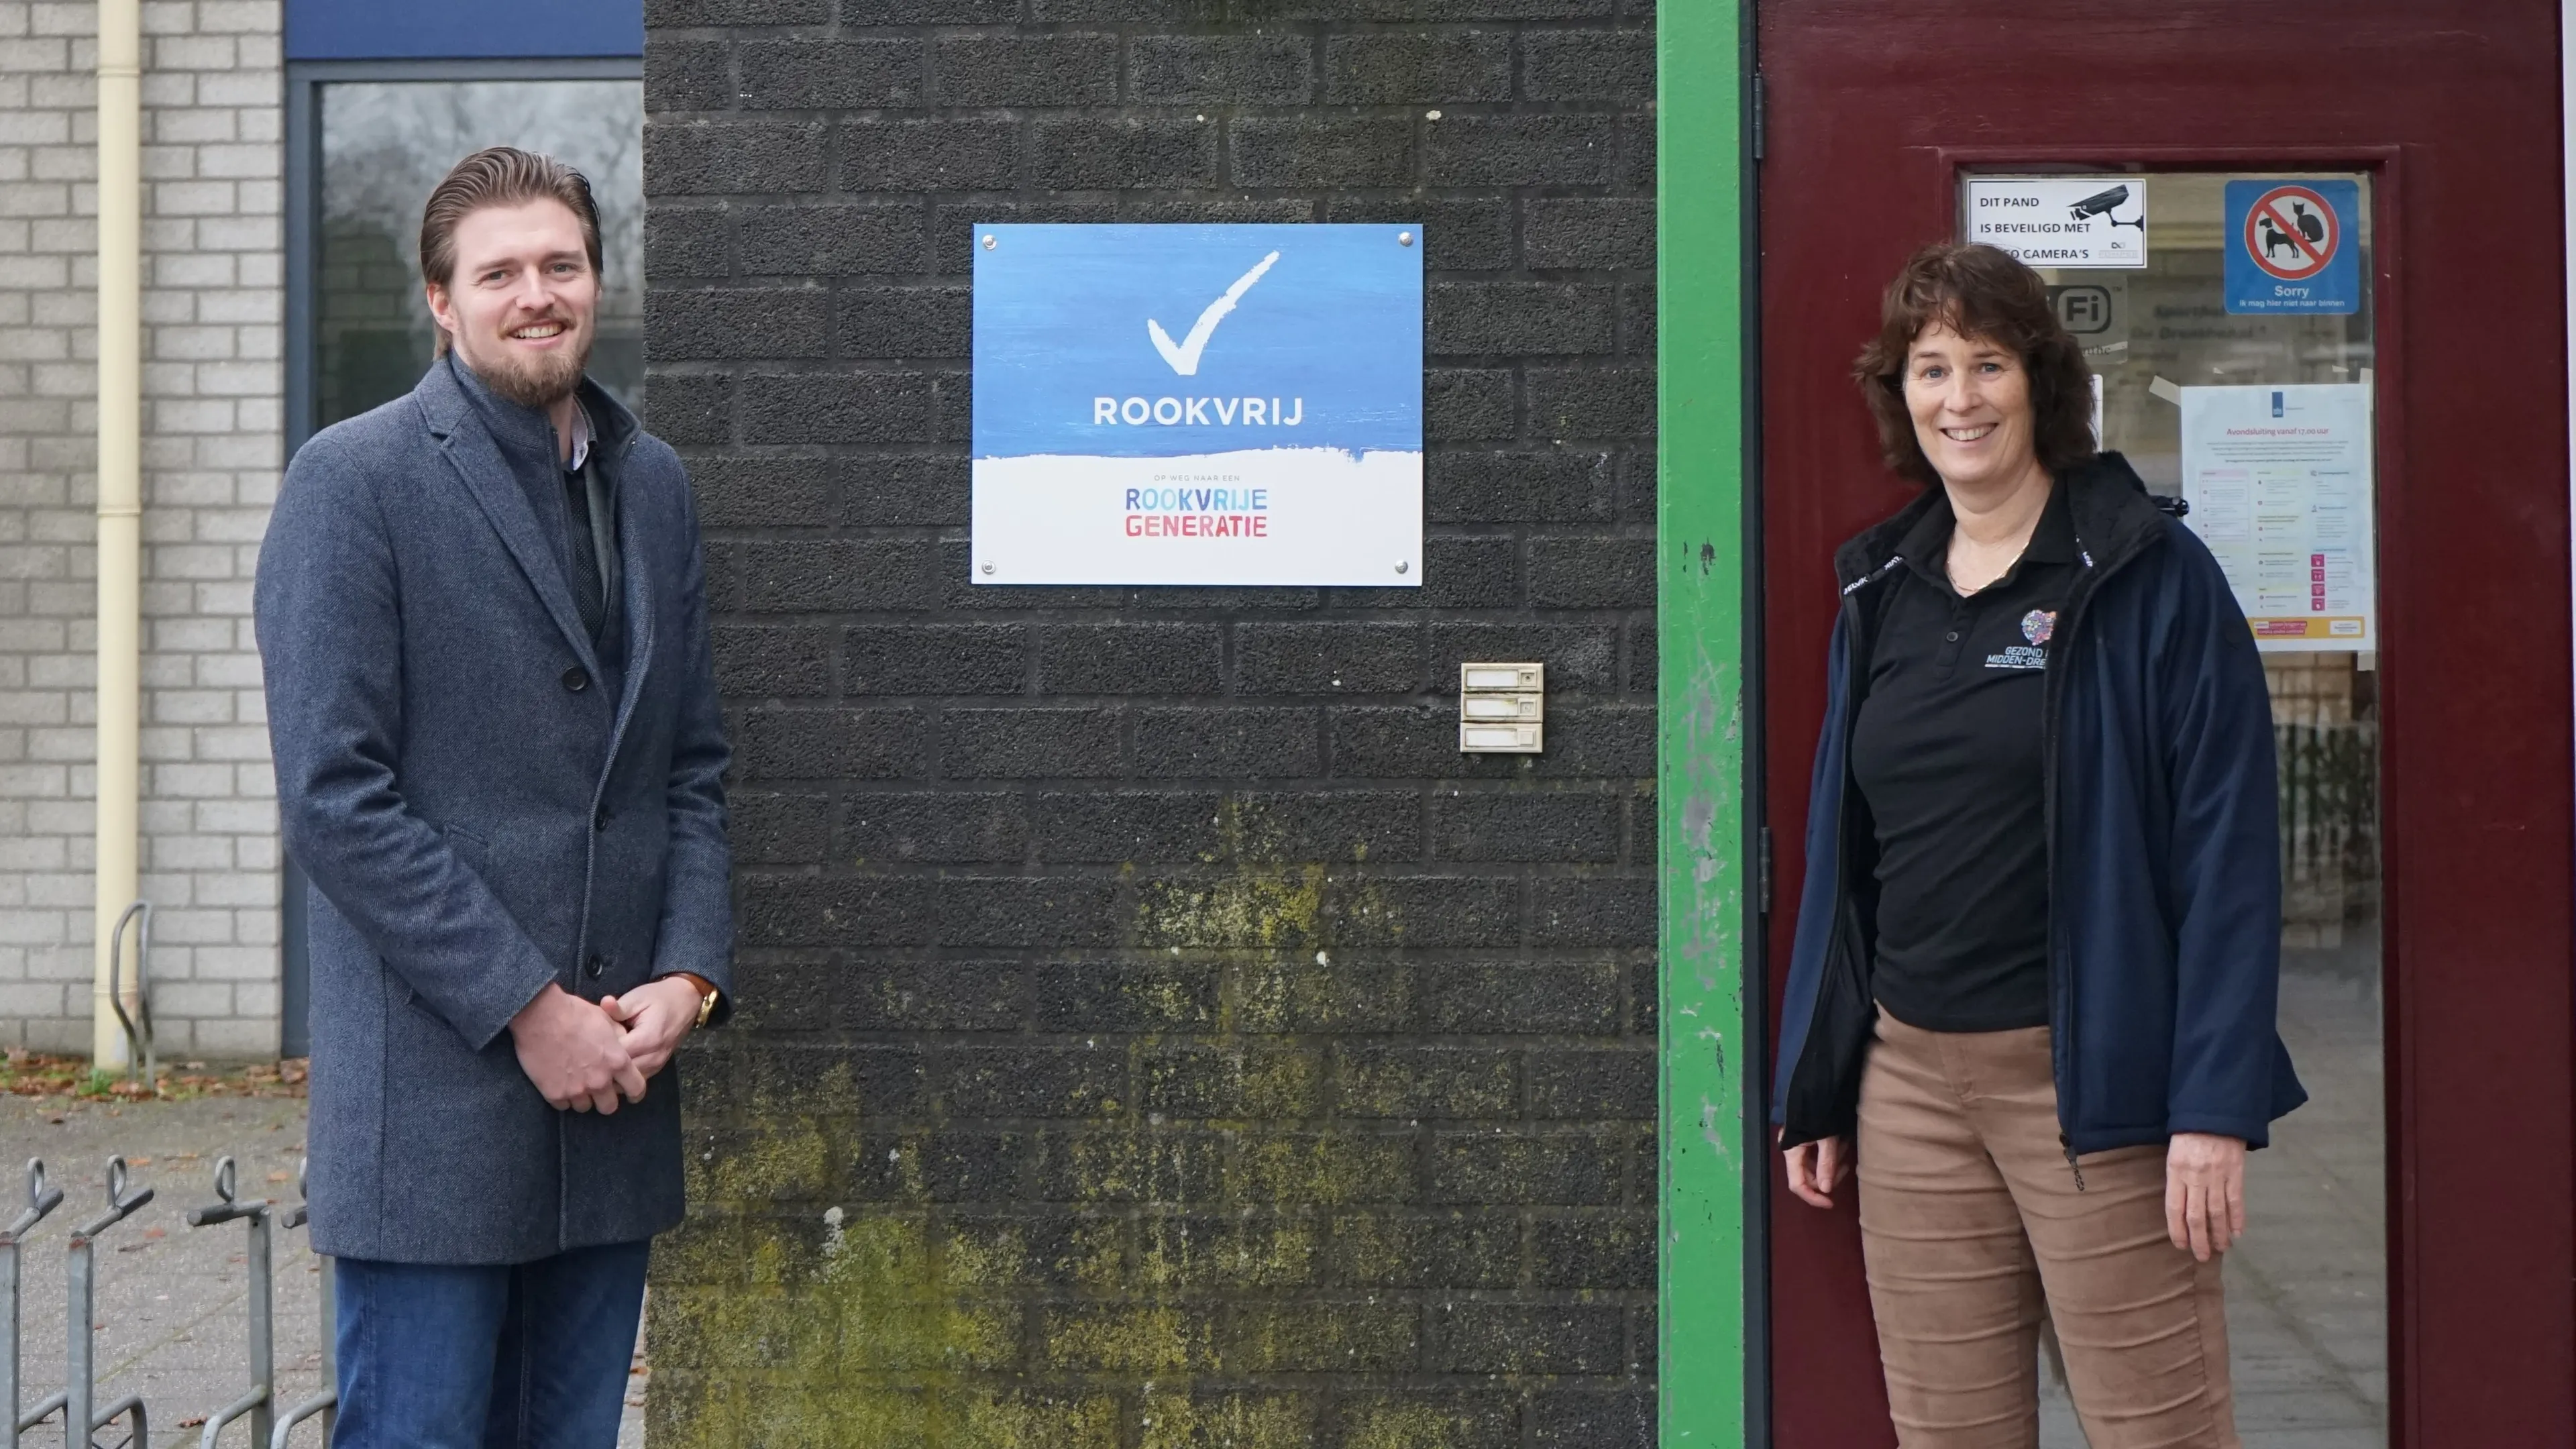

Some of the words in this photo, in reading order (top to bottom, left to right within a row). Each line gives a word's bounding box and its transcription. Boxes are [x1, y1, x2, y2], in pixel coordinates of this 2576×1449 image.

[1980, 198, 2000, 207] DIT
[2004, 198, 2039, 207] PAND
[1980, 223, 1991, 233] IS
[1995, 223, 2061, 233] BEVEILIGD
[2065, 223, 2091, 232] MET
[2023, 249, 2089, 259] CAMERA'S
[2275, 285, 2310, 299] Sorry
[2248, 300, 2265, 308] mag
[1094, 397, 1303, 426] ROOKVRIJ
[2226, 428, 2276, 437] Avondsluiting
[2277, 427, 2297, 435] vanaf
[1126, 488, 1267, 511] ROOKVRIJE
[1126, 515, 1267, 537] GENERATIE
[2005, 646, 2043, 658] GEZOND
[1986, 654, 2047, 665] MIDDEN-DRE
